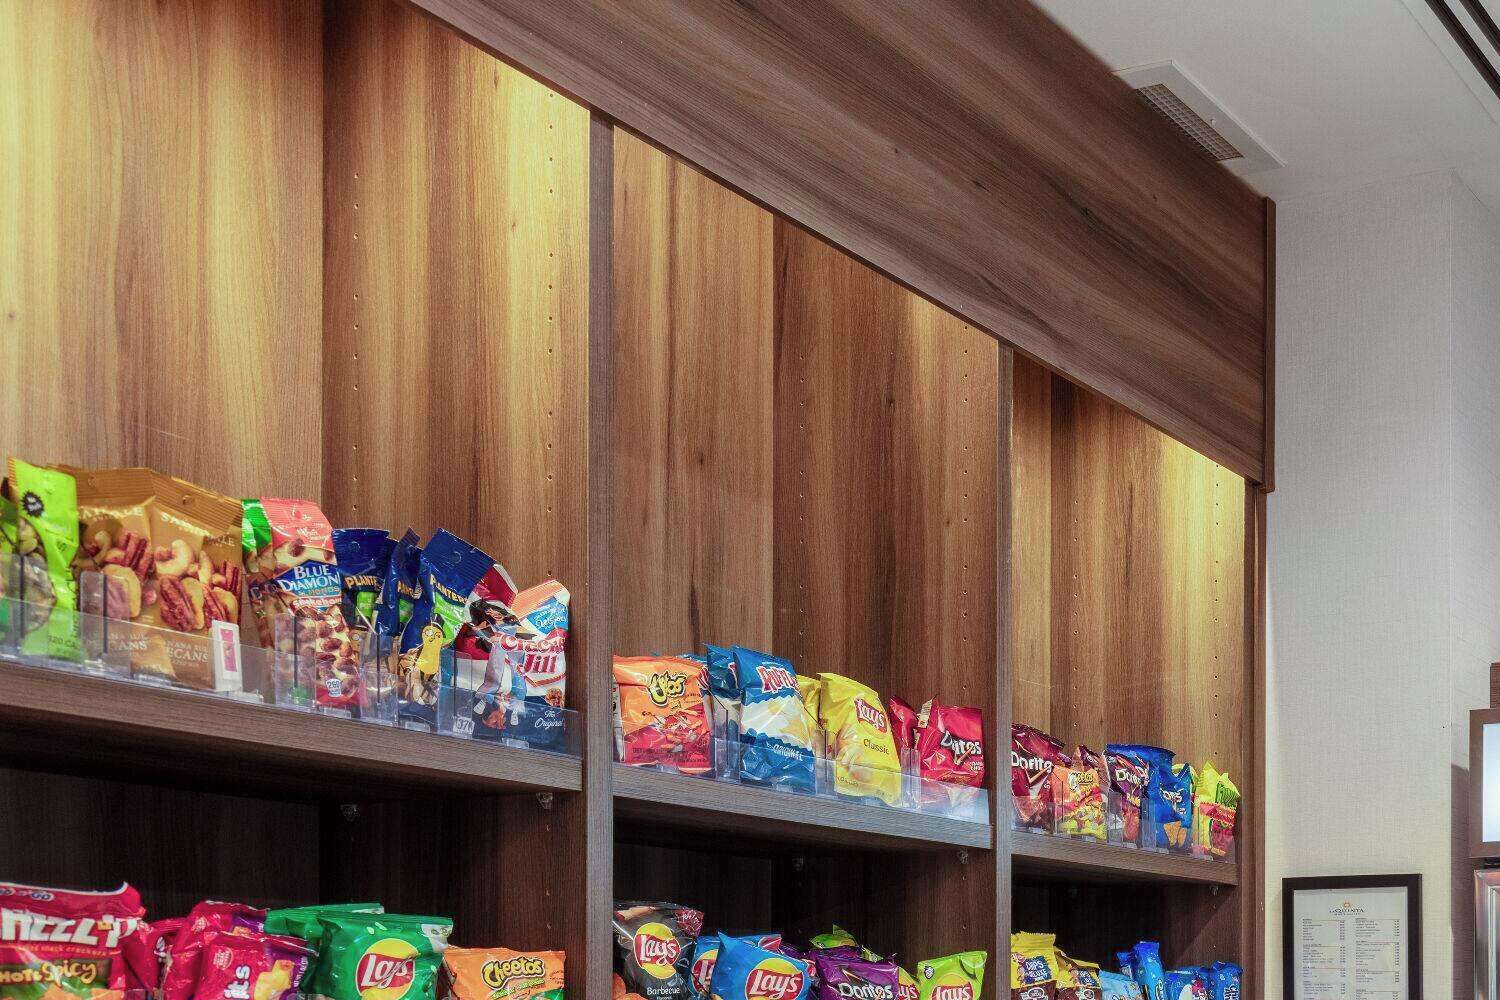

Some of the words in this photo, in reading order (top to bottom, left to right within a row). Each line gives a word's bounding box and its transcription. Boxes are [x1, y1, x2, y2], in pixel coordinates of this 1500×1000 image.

[293, 564, 330, 580] BLUE
[522, 651, 558, 674] Jill
[863, 737, 891, 755] Classic
[639, 933, 677, 967] Lay's
[41, 959, 98, 986] Spicy
[482, 956, 545, 988] Cheetos
[646, 985, 681, 996] Barbecue
[748, 970, 802, 1000] Lay's
